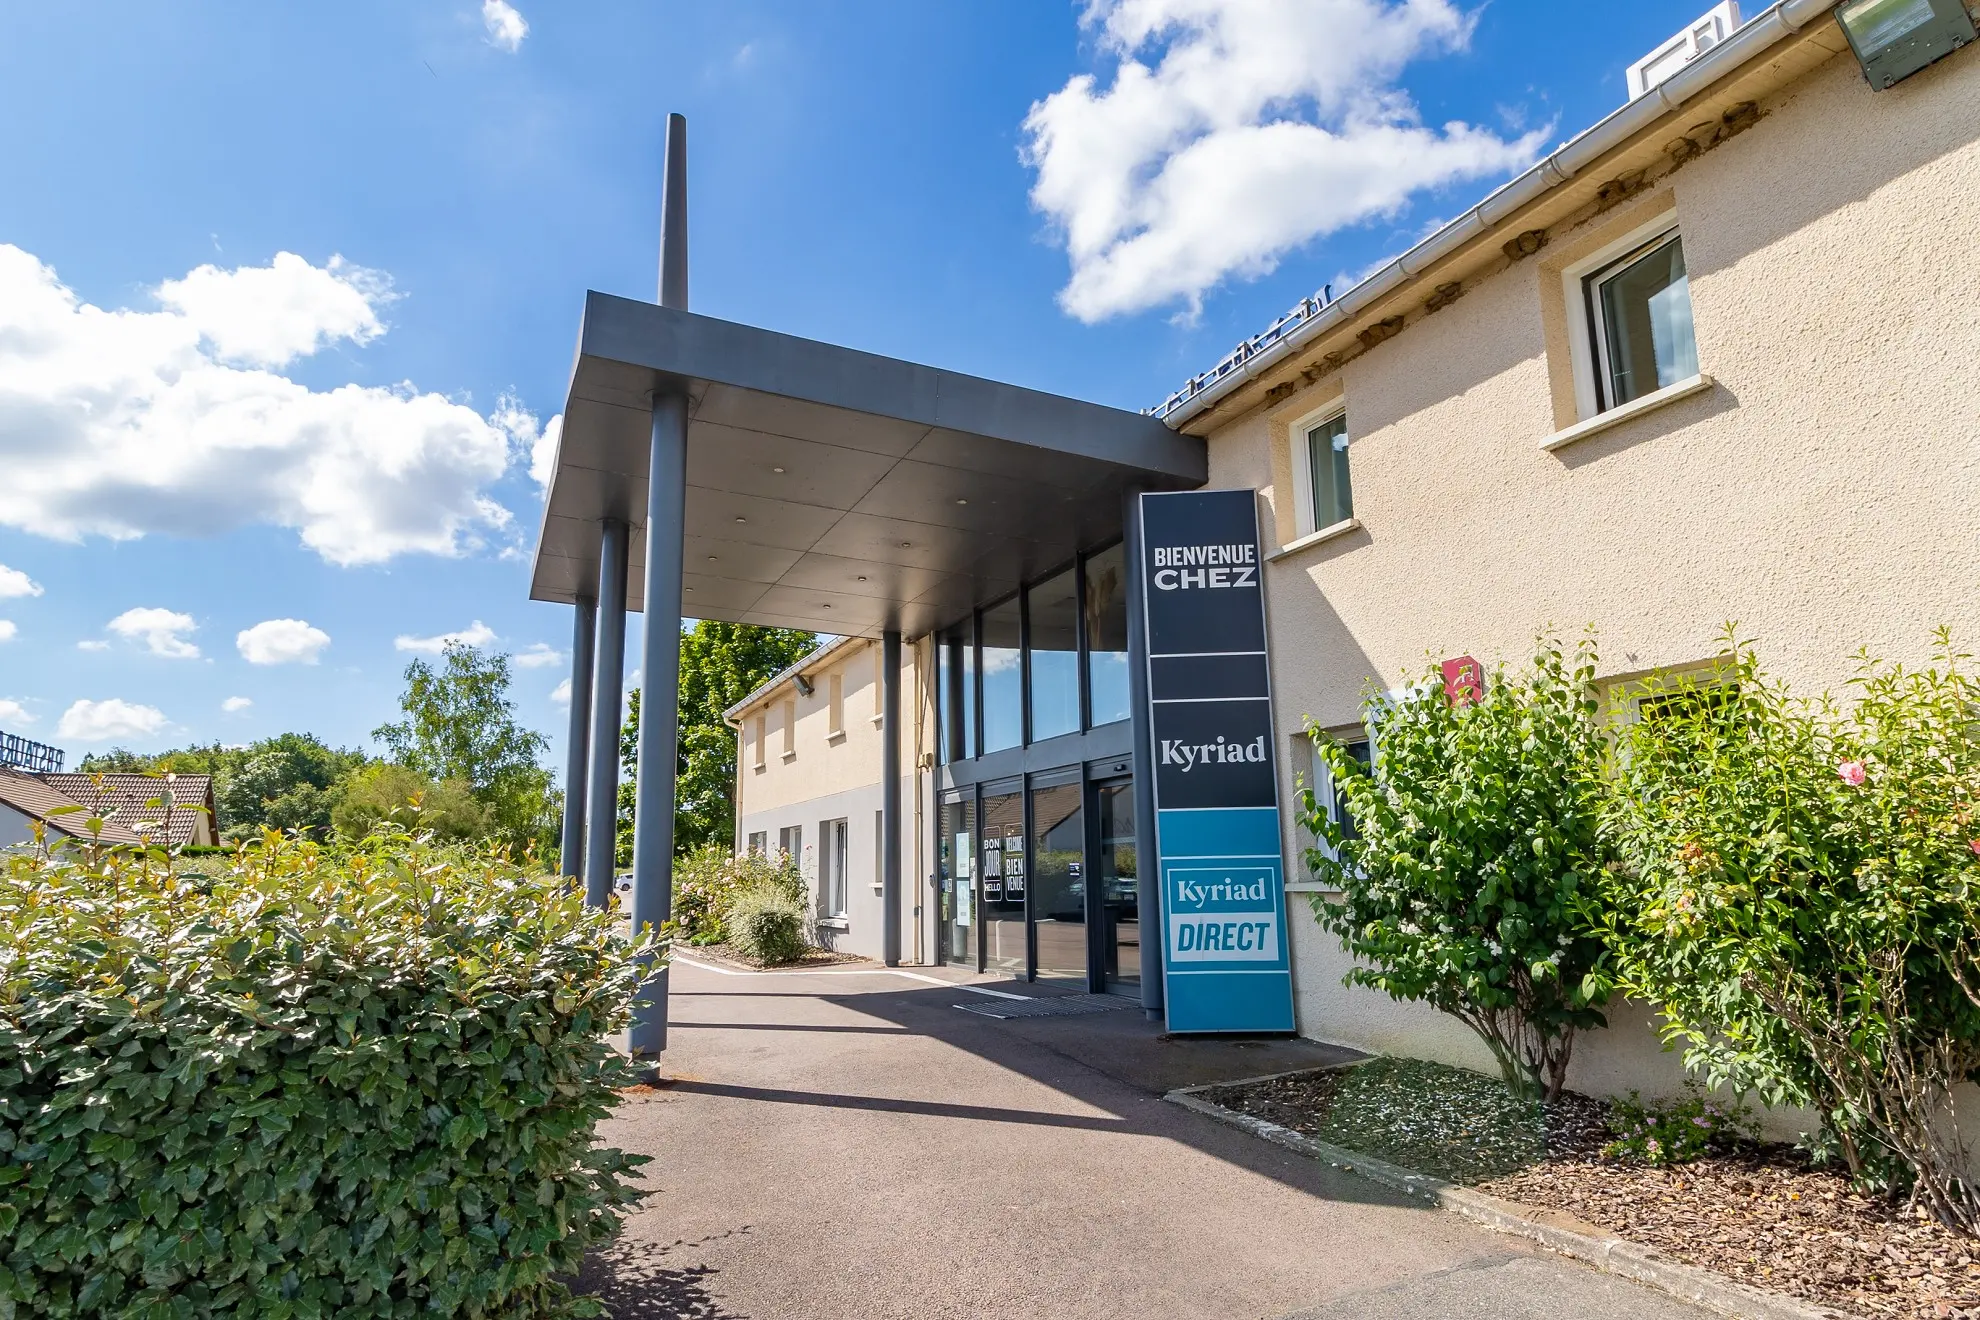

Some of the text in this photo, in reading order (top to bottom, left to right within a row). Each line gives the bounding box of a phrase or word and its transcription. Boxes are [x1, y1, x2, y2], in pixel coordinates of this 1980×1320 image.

[1154, 544, 1255, 567] BIENVENUE
[1154, 567, 1257, 590] CHEZ
[1161, 736, 1266, 773] Kyriad
[984, 839, 1000, 849] BON
[985, 850, 1000, 876] JOUR
[1006, 859, 1023, 875] BIEN
[984, 883, 1000, 892] HELLO
[1007, 876, 1023, 890] VENUE
[1178, 878, 1267, 909] Kyriad
[1177, 922, 1271, 952] DIRECT
